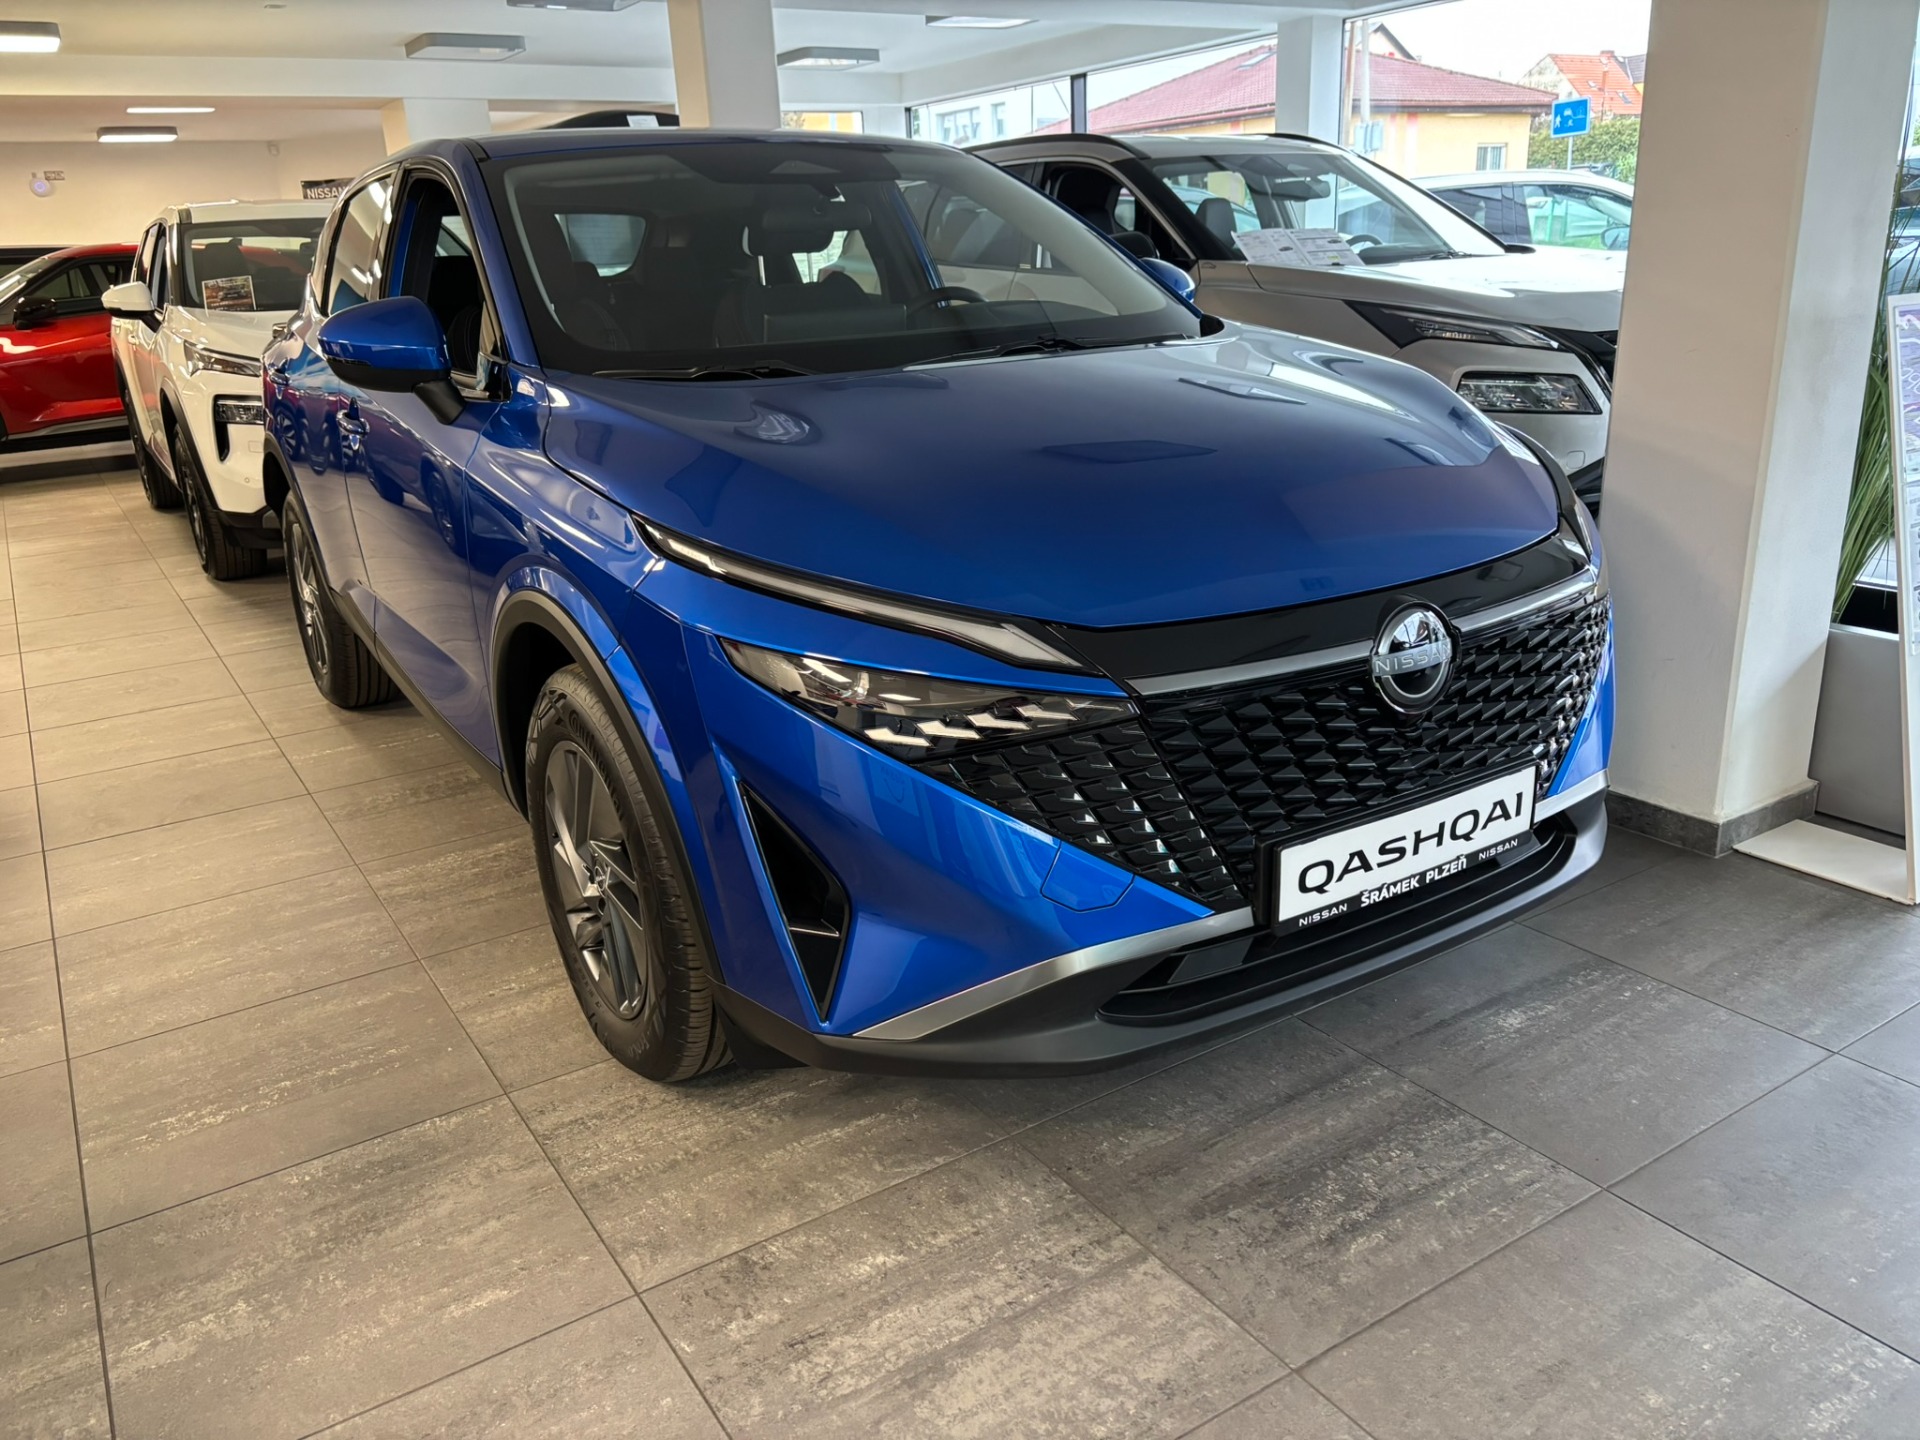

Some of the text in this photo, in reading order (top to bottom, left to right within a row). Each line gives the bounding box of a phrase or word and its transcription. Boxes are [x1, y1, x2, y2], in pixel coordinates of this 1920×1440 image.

[307, 187, 346, 199] NISSAN
[1375, 643, 1450, 673] NISSAN
[1298, 791, 1524, 895] QASHQAI
[1299, 903, 1347, 927] NISSAN
[1361, 875, 1420, 907] ŠRÁMEK
[1478, 839, 1518, 860] NISSAN
